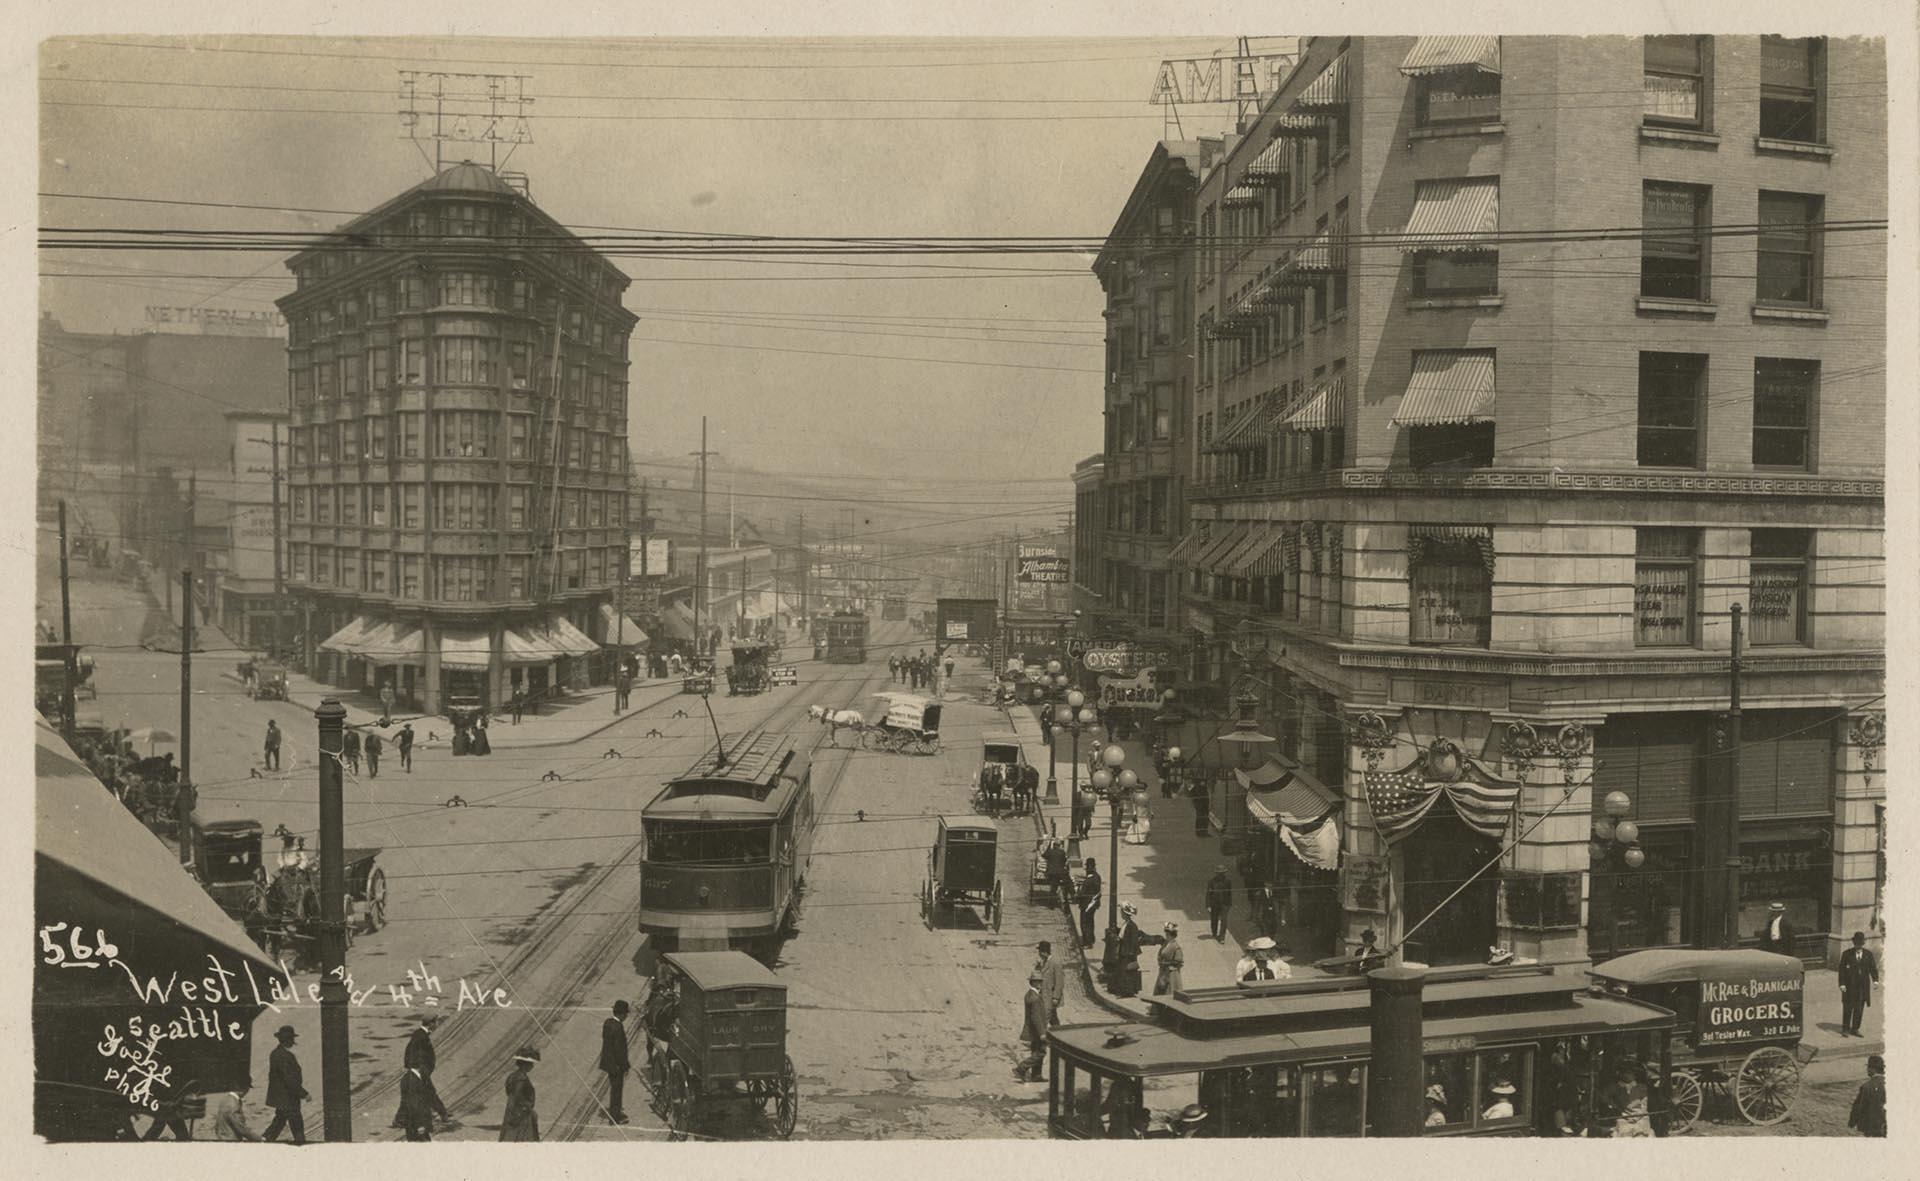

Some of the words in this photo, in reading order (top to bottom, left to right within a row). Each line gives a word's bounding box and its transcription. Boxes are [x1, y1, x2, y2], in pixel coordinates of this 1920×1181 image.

[1016, 560, 1068, 576] Alhambra
[1031, 572, 1067, 582] THEATRE
[1087, 652, 1170, 667] OYSTERS
[1741, 985, 1749, 997] &
[1711, 1001, 1794, 1025] GROCERS.
